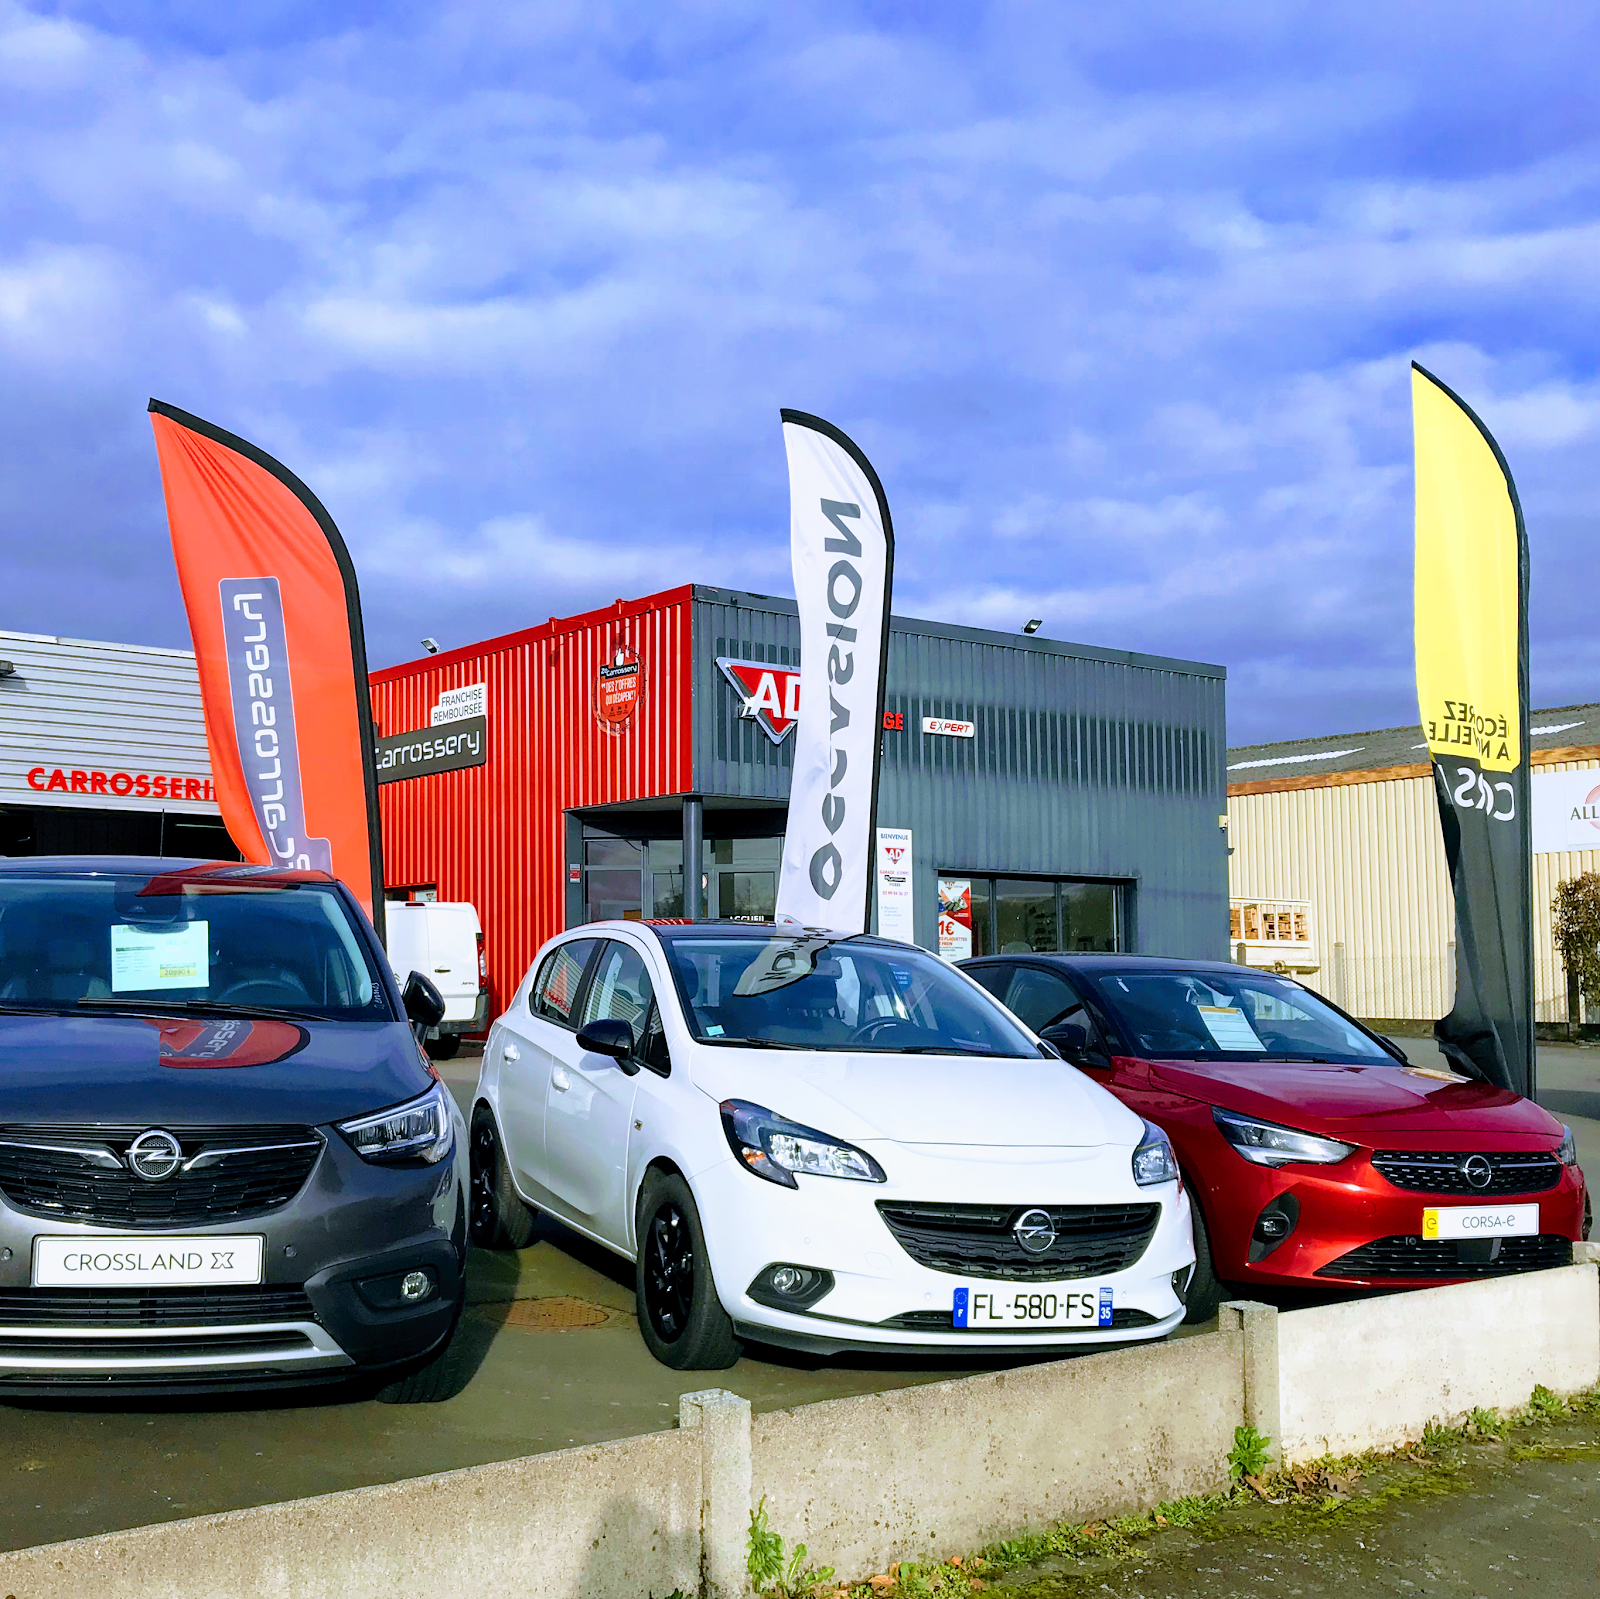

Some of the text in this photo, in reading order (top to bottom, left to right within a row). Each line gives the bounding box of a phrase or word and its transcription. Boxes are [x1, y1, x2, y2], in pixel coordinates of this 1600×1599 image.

[441, 688, 483, 707] FRANCHISE
[433, 700, 483, 723] REMBOURSÉE
[883, 711, 904, 731] GE
[929, 720, 970, 733] EXPERT
[27, 766, 217, 802] CARROSSERI
[1426, 1214, 1516, 1230] e CORSA-e
[63, 1252, 235, 1271] CROSSLAND X
[957, 1308, 964, 1319] F
[973, 1294, 1095, 1320] FL-580-FS
[1100, 1307, 1111, 1319] 35
